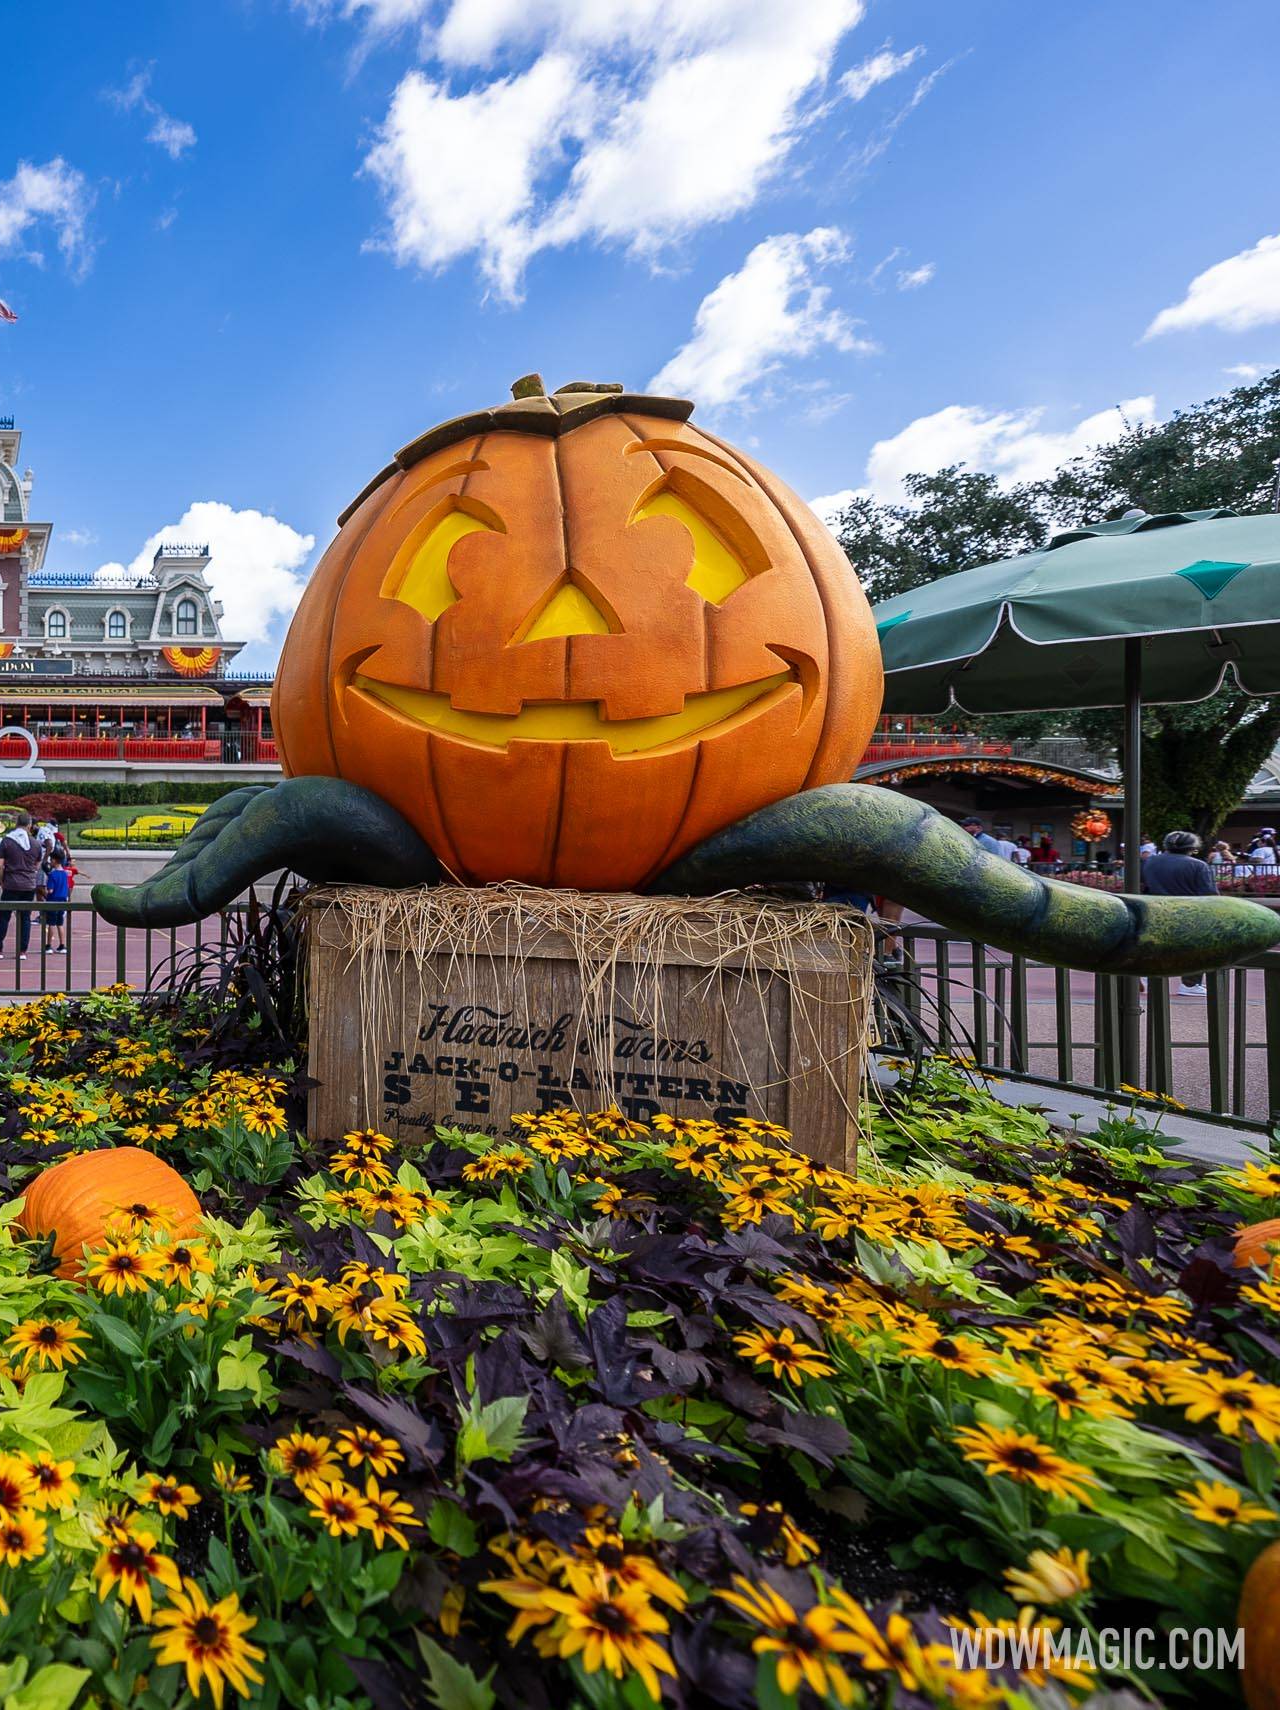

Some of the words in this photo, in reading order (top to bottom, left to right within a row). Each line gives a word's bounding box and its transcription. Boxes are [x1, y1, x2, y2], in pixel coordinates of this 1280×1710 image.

[69, 687, 140, 695] RAILROAD
[419, 1003, 573, 1052] Hartrich
[383, 1051, 751, 1106] JACK-O-LANTERN
[486, 1123, 498, 1136] in
